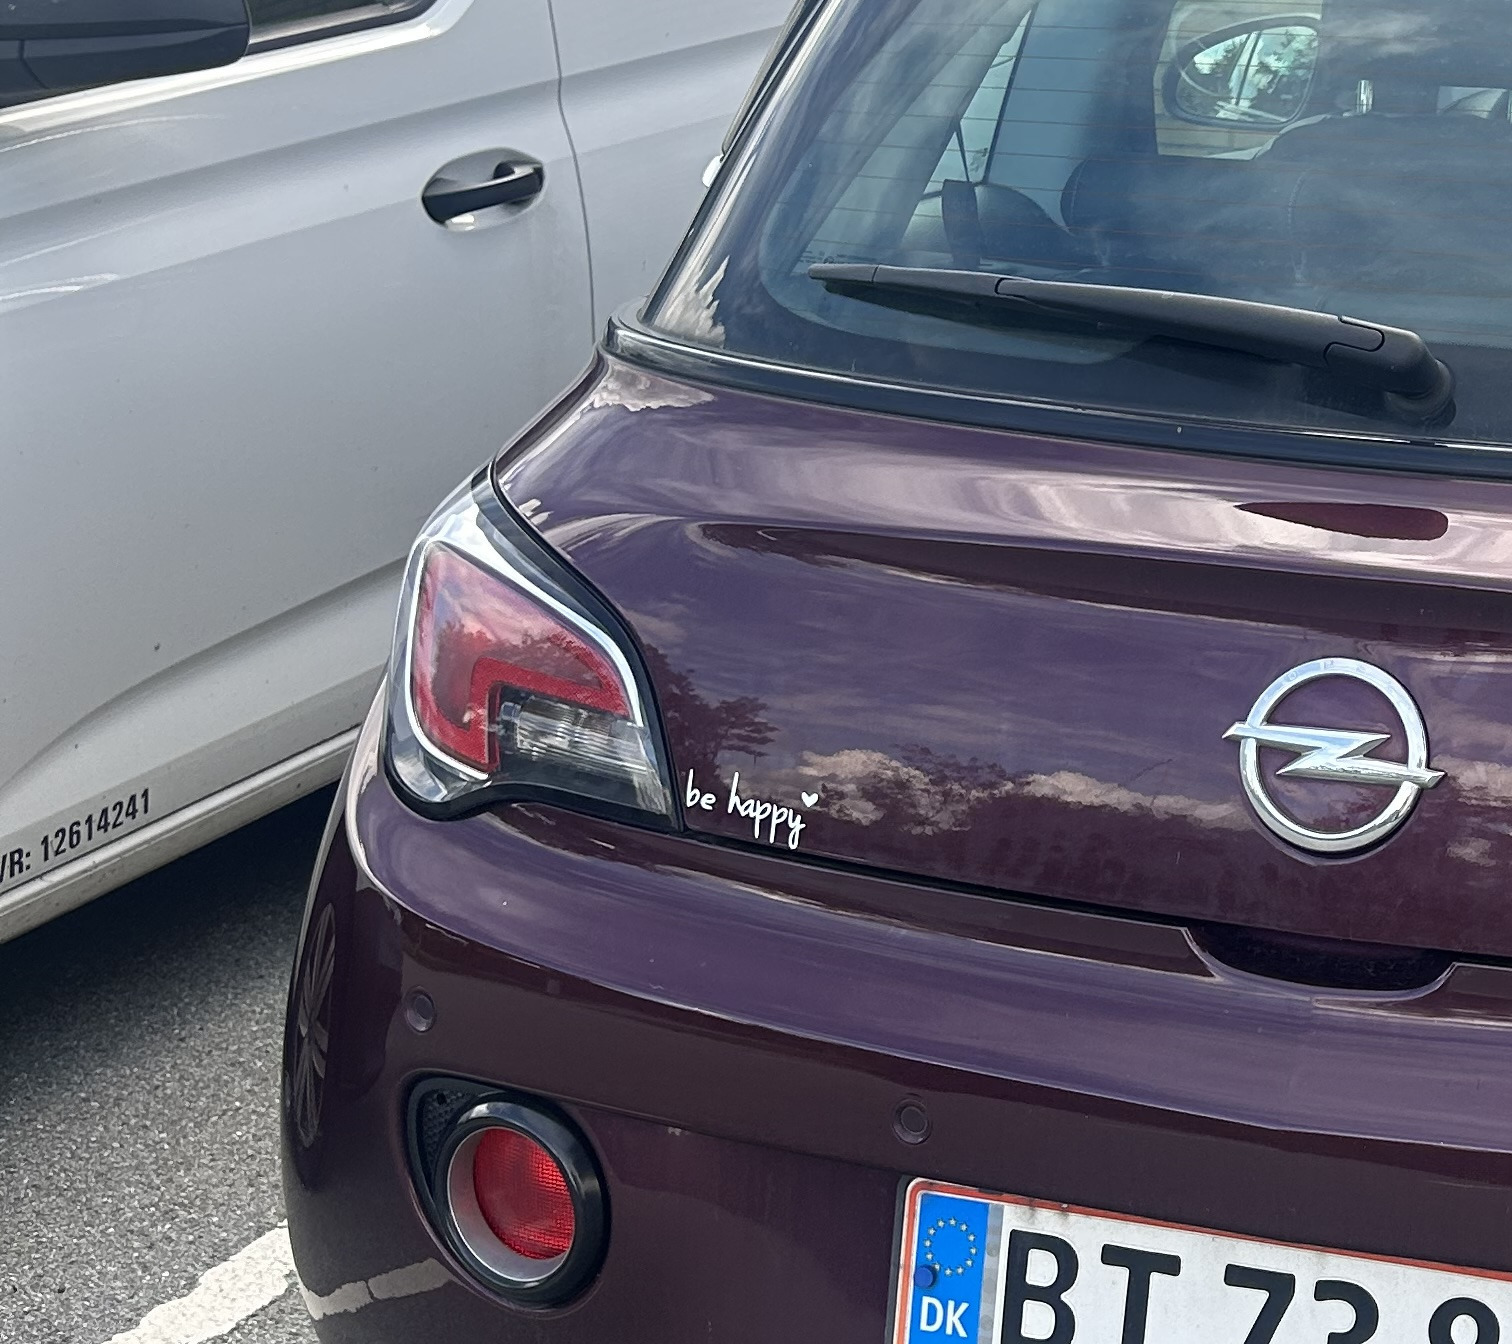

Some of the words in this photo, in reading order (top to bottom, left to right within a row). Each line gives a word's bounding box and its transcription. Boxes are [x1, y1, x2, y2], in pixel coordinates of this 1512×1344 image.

[40, 787, 150, 862] 12614241
[686, 768, 717, 810] be
[727, 771, 806, 850] happy
[919, 1295, 970, 1339] DK
